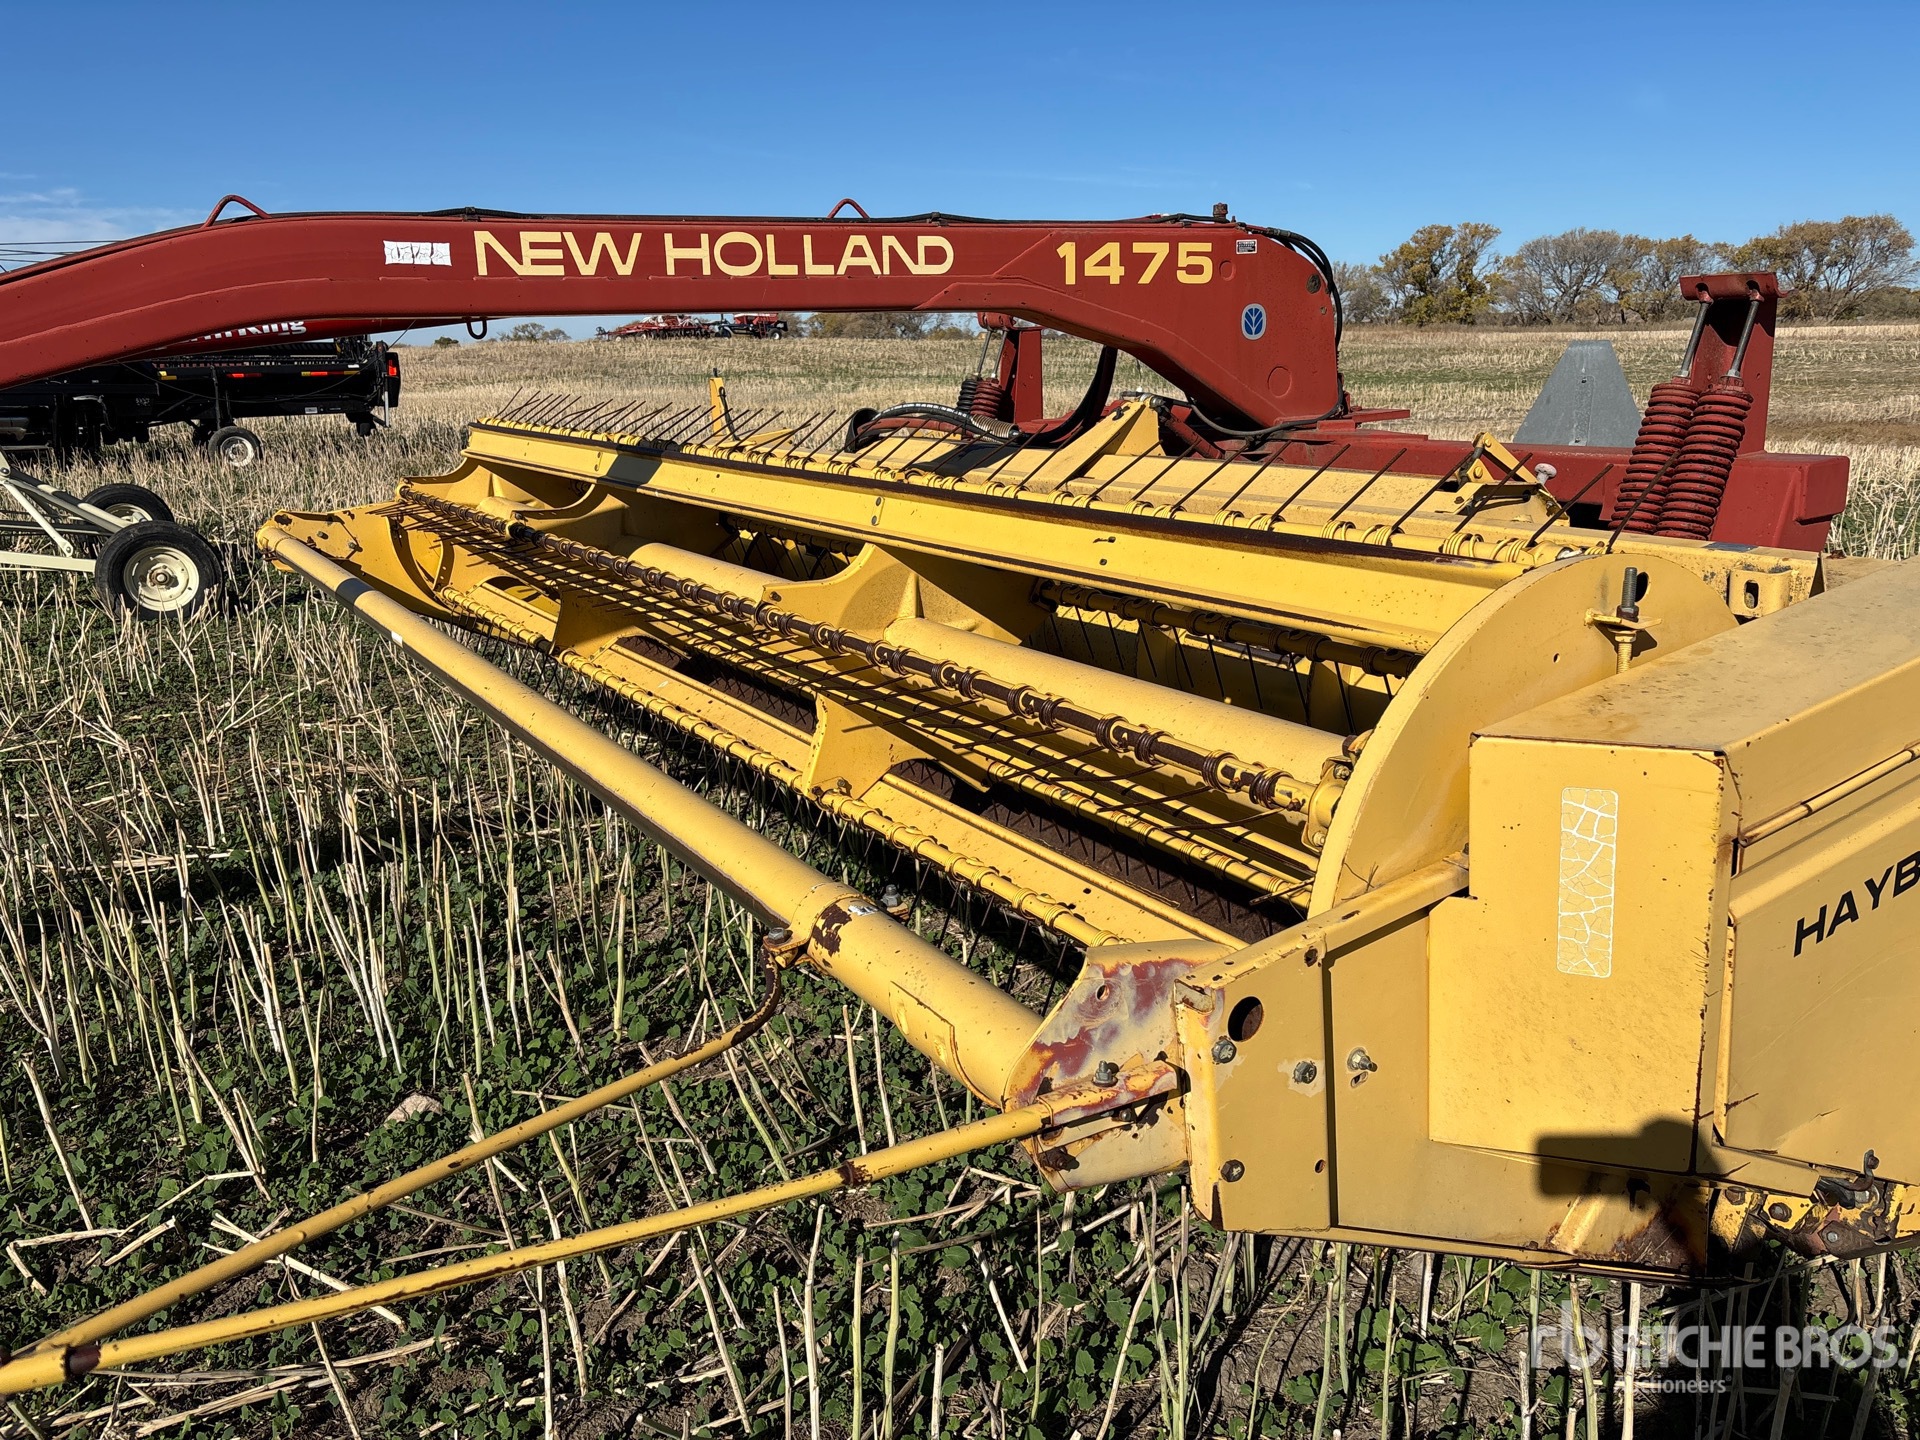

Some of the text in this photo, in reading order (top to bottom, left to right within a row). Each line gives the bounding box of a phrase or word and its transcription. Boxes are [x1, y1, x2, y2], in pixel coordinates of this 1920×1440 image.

[473, 230, 955, 276] NEW HOLLAND
[1056, 241, 1213, 285] 1475
[1793, 850, 1920, 958] HAYB
